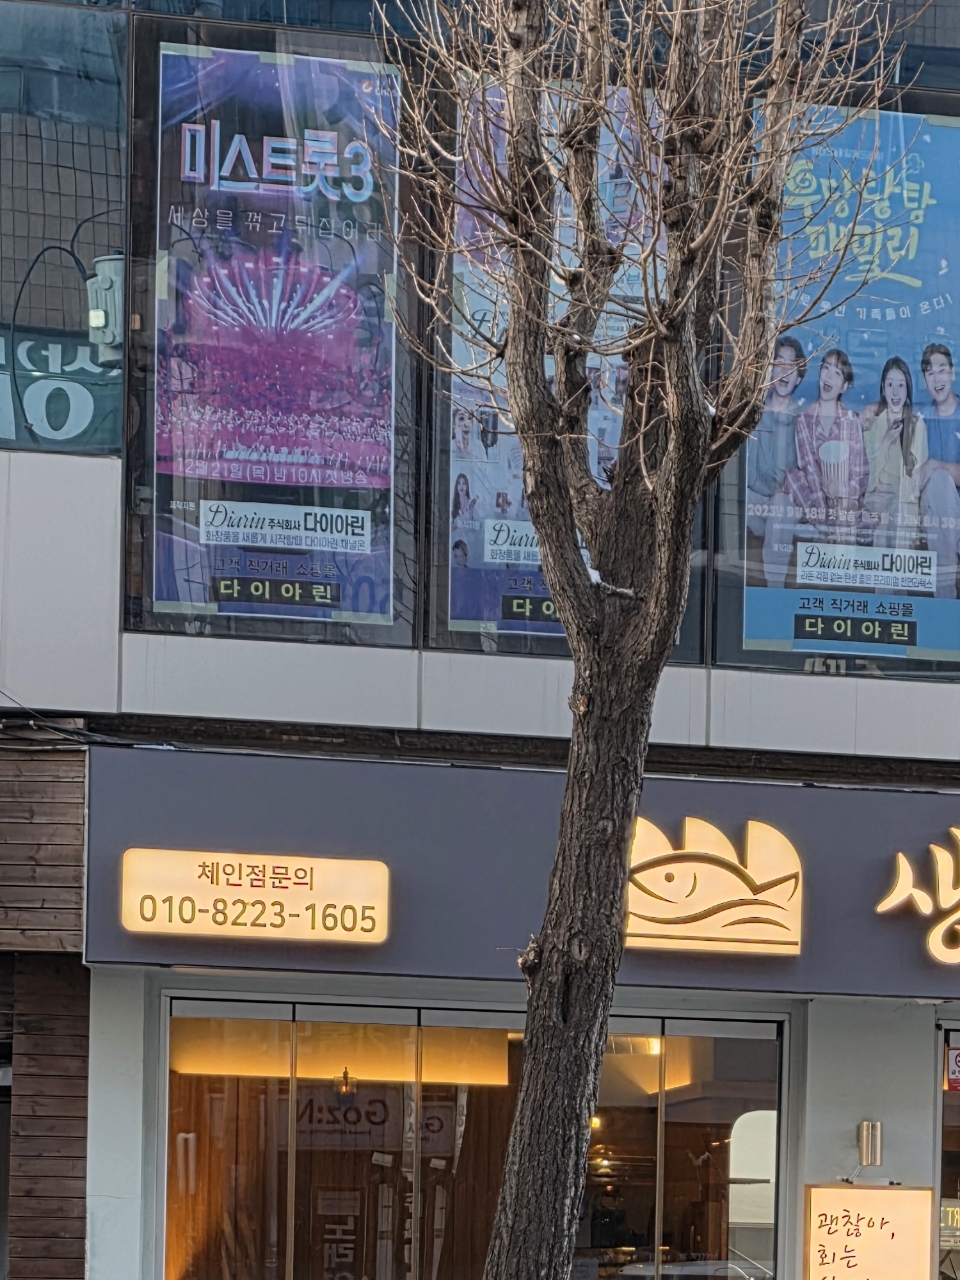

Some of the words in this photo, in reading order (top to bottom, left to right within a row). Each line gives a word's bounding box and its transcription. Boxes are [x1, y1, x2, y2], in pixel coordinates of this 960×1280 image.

[180, 119, 374, 203] 미스트롯3
[168, 204, 233, 230] 세상을
[245, 211, 286, 234] 꺾고
[805, 221, 923, 288] 패밀리
[856, 306, 911, 321] 가족들이
[919, 293, 953, 315] 온다!
[177, 458, 208, 475] 12월
[211, 462, 243, 480] 21일
[246, 466, 270, 482] (목)
[290, 469, 322, 484] 10시
[205, 503, 266, 530] Diarin
[268, 518, 301, 531] 주식회사
[304, 511, 365, 537] 다이아린
[489, 522, 541, 548] Diari
[213, 557, 241, 572] 고객
[248, 559, 288, 576] 직거래
[296, 563, 337, 579] 쇼핑몰
[802, 545, 852, 570] Diarin
[853, 558, 880, 571] 주식회사
[881, 554, 932, 576] 다이아린
[220, 578, 332, 603] 다이아린
[507, 577, 533, 591] 고객
[798, 597, 825, 611] 고객
[831, 598, 869, 614] 직거래
[875, 602, 914, 617] 쇼핑몰
[805, 617, 909, 640] 다이아린
[197, 861, 314, 891] 체인점문의
[139, 894, 376, 933] 010-8223-1605
[817, 1209, 895, 1240] 괜찮아,
[817, 1244, 858, 1269] 회는
